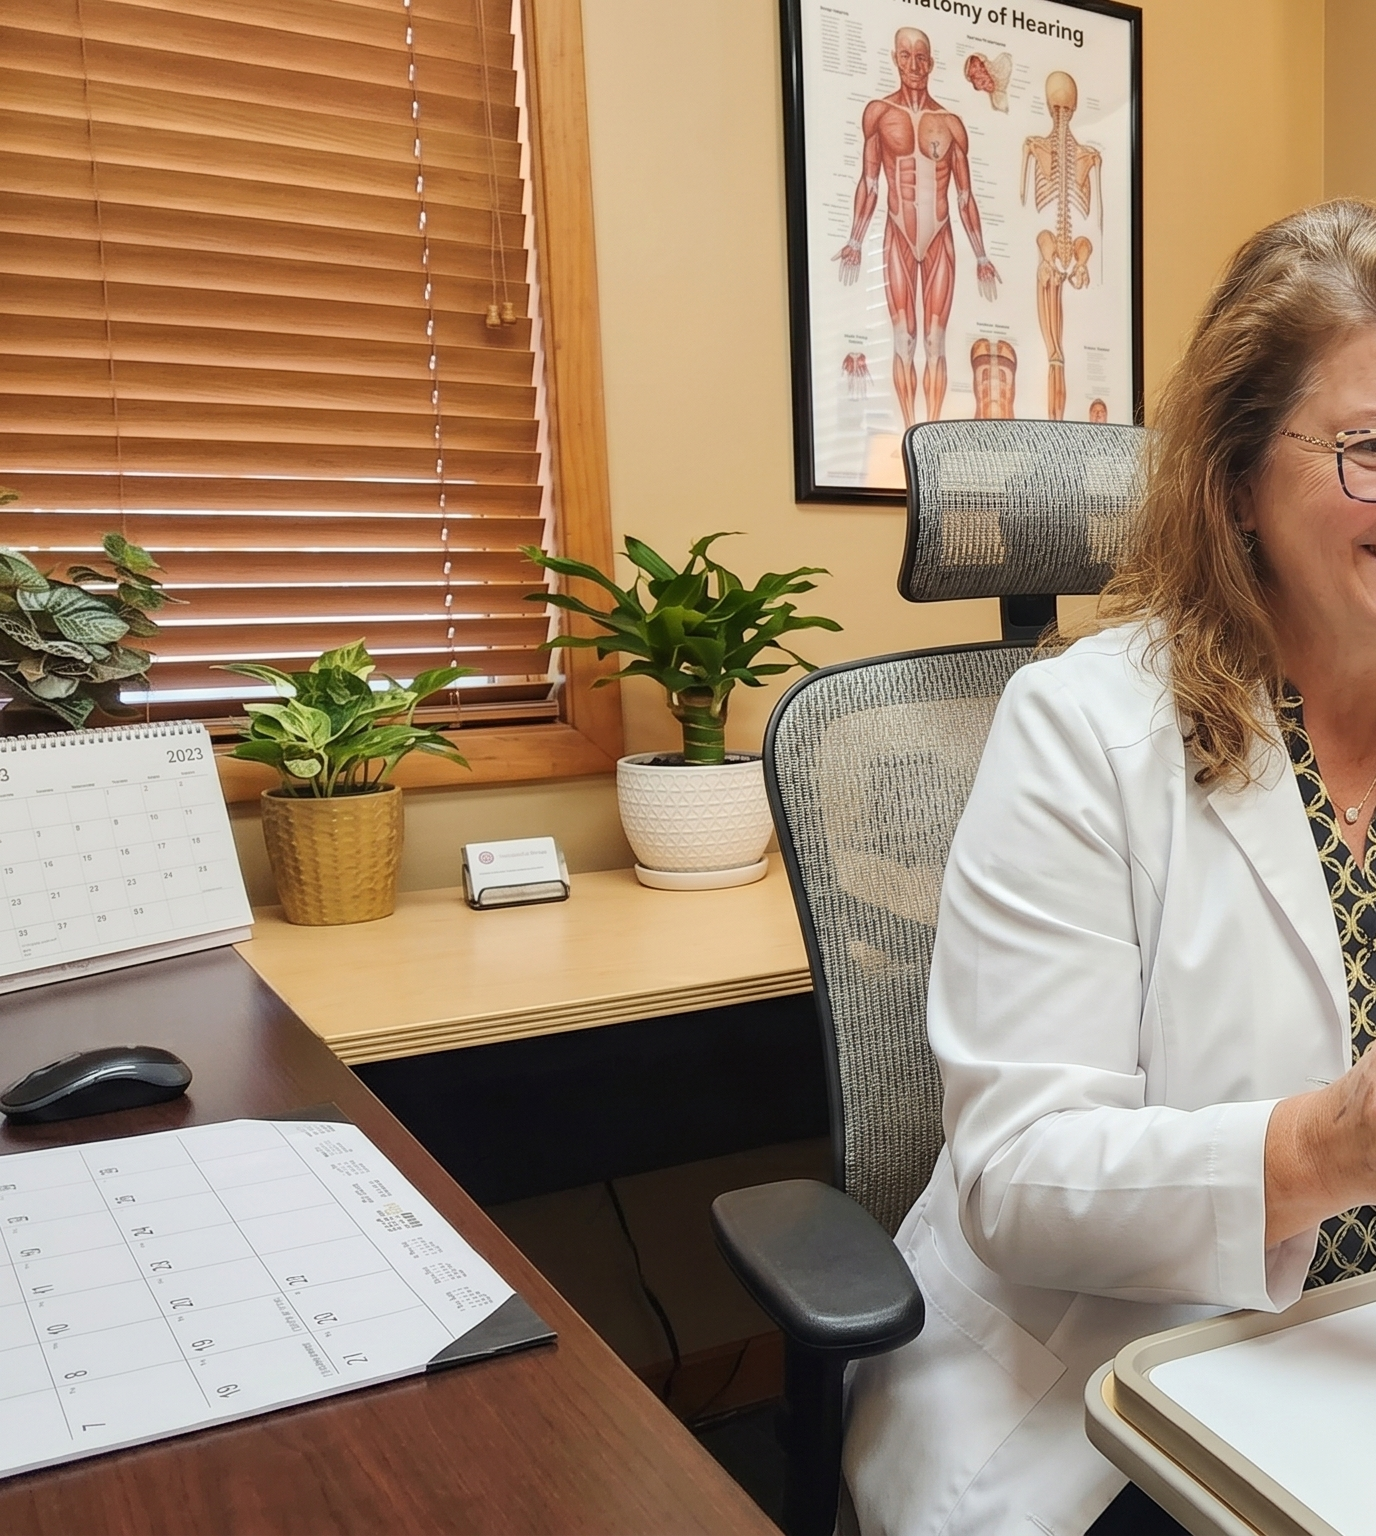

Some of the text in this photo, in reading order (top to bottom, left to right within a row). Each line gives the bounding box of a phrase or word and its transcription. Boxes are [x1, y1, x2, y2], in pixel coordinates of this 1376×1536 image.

[988, 7, 1007, 25] of
[1012, 10, 1084, 48] Hearing
[167, 747, 204, 764] 2023
[314, 1312, 338, 1325] 20
[192, 1339, 215, 1352] 19
[342, 1352, 369, 1366] 21
[65, 1370, 88, 1379] 8
[217, 1383, 241, 1398] 19
